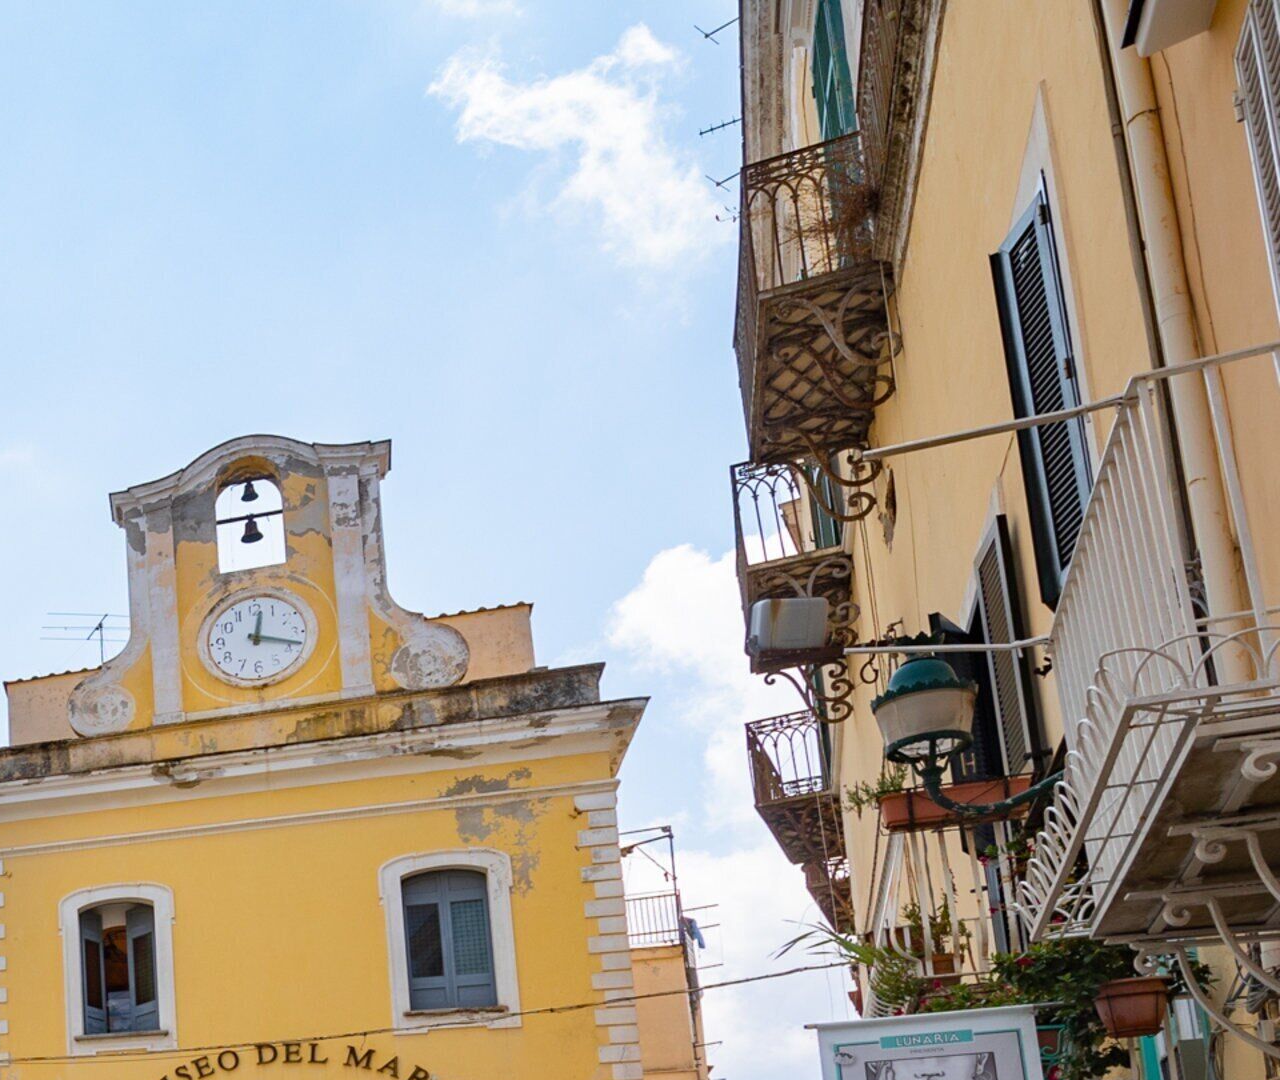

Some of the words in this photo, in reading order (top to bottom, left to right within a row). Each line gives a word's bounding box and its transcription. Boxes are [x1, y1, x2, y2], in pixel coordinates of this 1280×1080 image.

[220, 621, 234, 634] 10
[223, 651, 232, 664] 8
[254, 660, 263, 674] 6
[896, 1033, 960, 1046] LUNARIA
[254, 1043, 329, 1066] DEL
